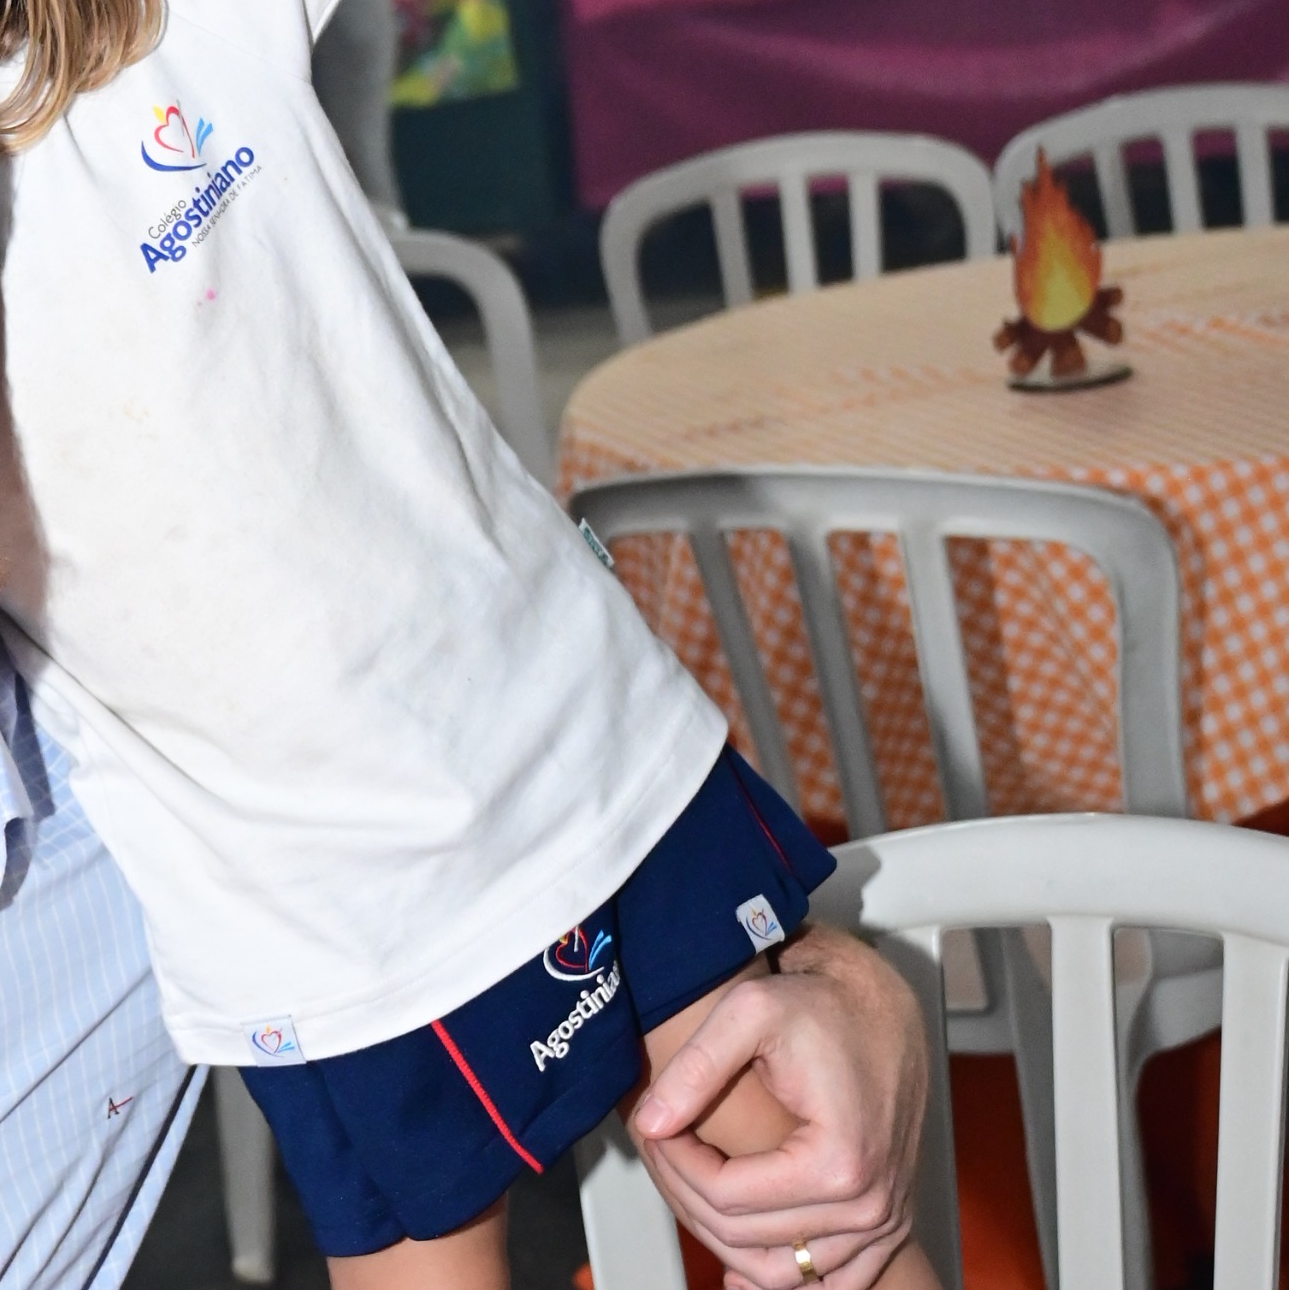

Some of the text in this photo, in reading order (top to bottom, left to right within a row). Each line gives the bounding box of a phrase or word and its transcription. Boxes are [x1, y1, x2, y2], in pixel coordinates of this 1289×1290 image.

[140, 147, 255, 273] Agostiniano
[148, 198, 187, 240] Colégio
[192, 225, 213, 248] NOSSA
